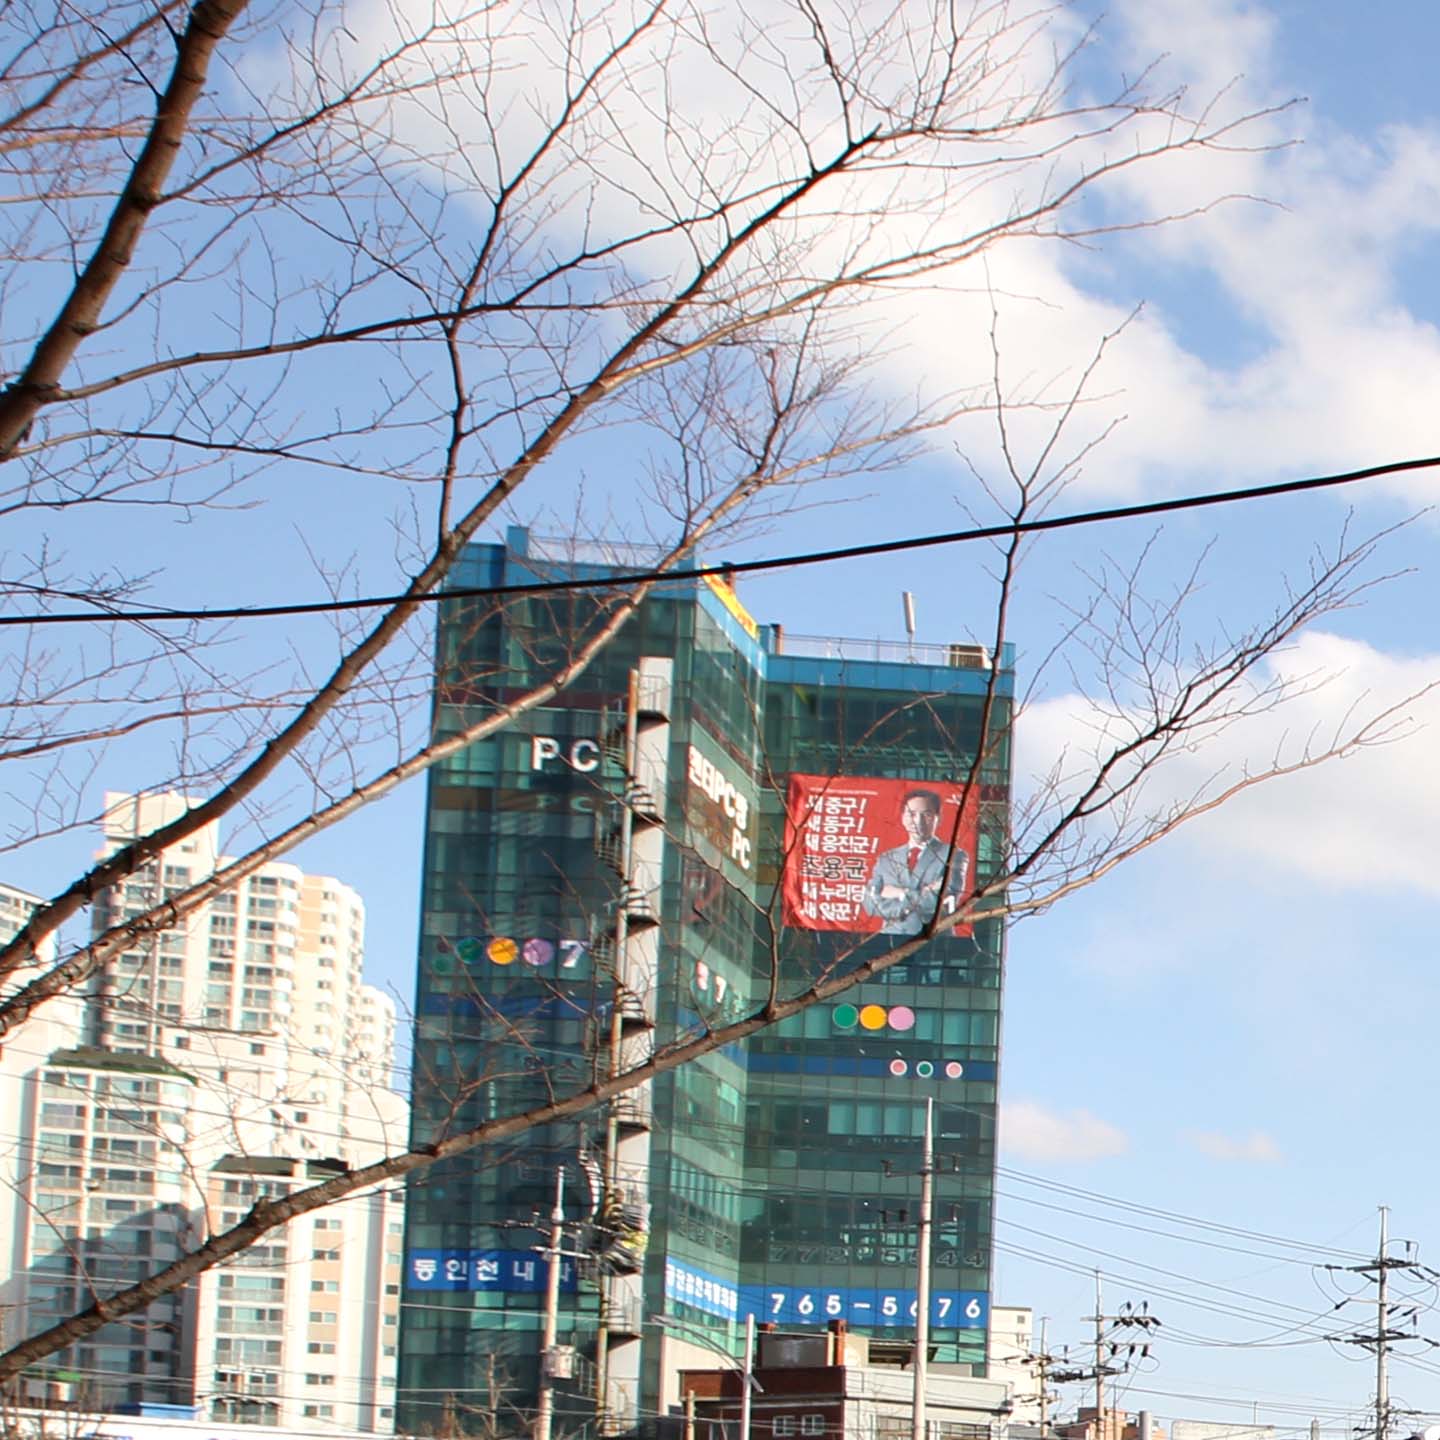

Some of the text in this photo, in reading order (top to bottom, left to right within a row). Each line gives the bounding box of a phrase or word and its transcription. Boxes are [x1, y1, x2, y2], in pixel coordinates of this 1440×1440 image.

[531, 736, 600, 772] PC
[826, 796, 867, 814] 중구!
[823, 817, 864, 833] 동구!
[801, 855, 866, 880] 조용균
